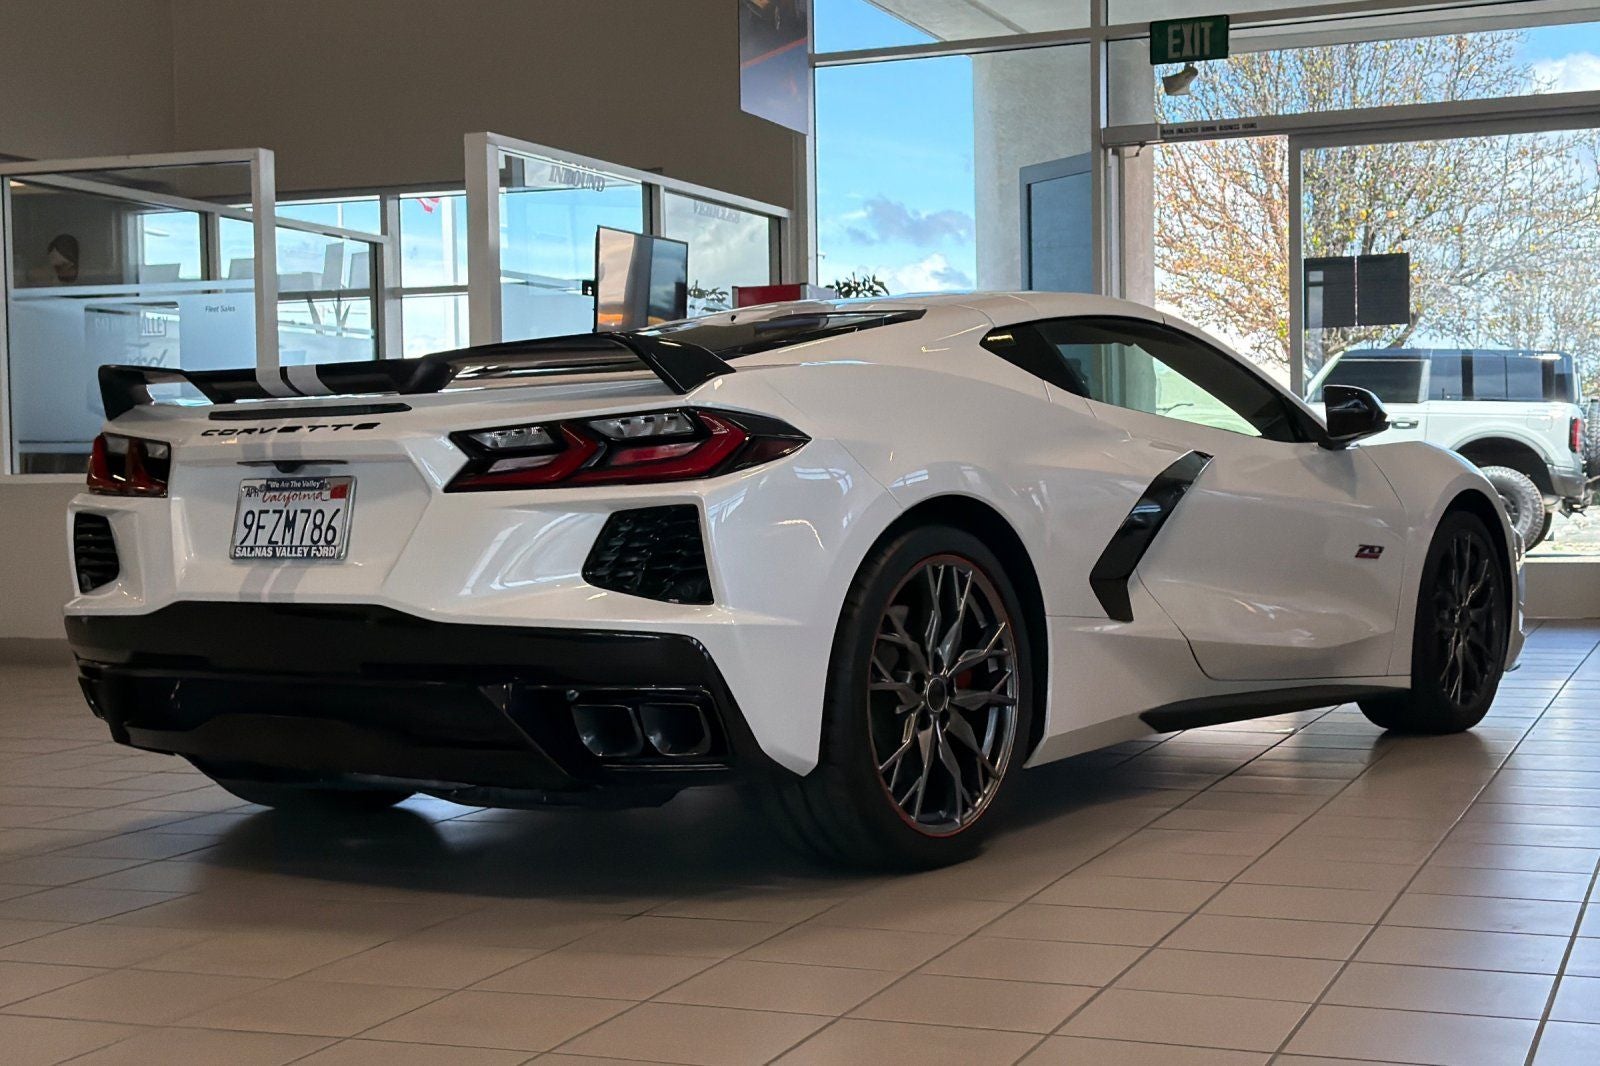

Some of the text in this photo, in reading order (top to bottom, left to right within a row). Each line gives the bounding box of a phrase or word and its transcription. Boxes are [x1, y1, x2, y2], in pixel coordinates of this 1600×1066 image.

[1167, 22, 1214, 58] EXIT
[201, 422, 381, 436] CORVETTE
[261, 490, 329, 507] California
[239, 508, 341, 546] 9FZM786
[235, 546, 336, 557] SALINAS VALLEY FORD
